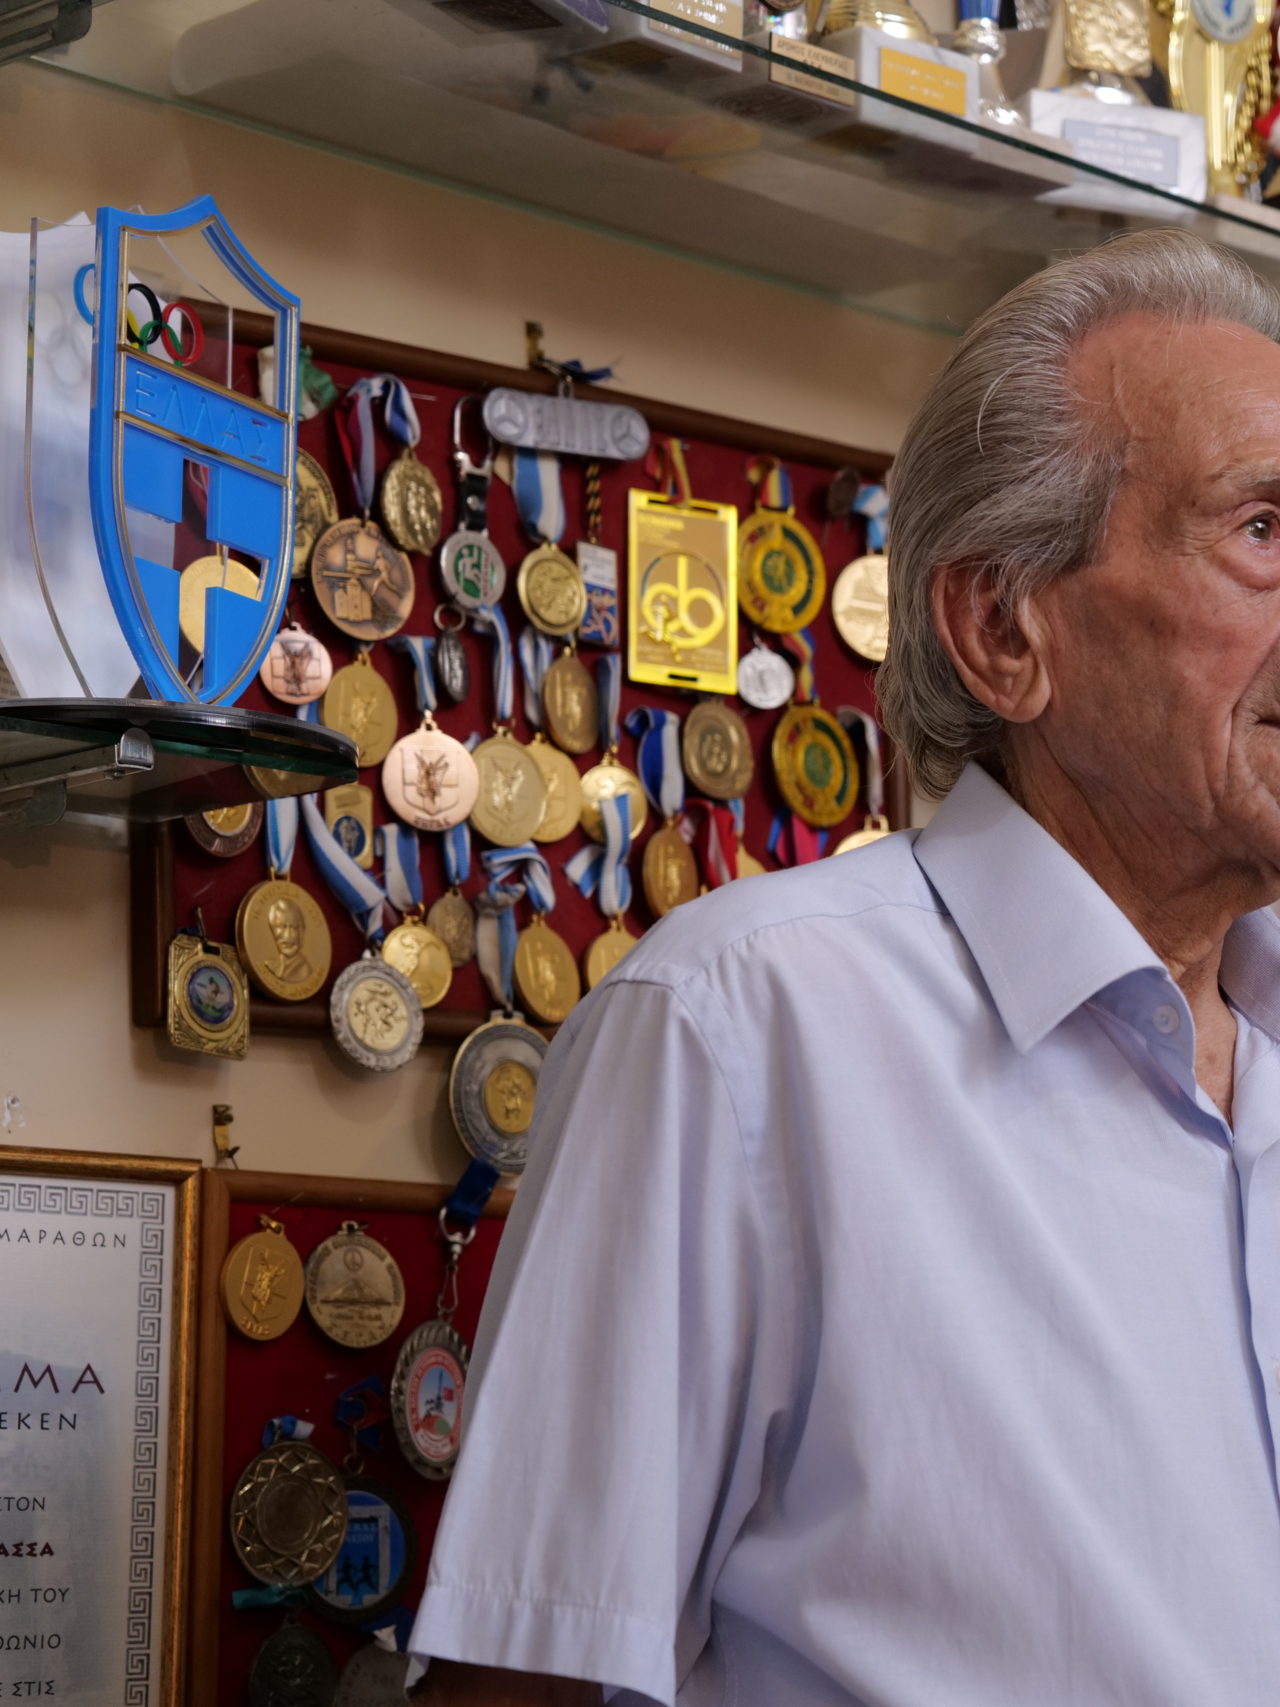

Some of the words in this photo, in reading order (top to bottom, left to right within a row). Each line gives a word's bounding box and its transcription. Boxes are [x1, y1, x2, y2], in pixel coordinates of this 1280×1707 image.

[0, 1363, 105, 1394] ΜΑ
[0, 1496, 46, 1511] ΤΟΝ
[0, 1541, 55, 1557] ΑΣΣΑ
[30, 1587, 70, 1603] ΤΟΥ
[12, 1680, 56, 1696] ΣΤΙΣ
